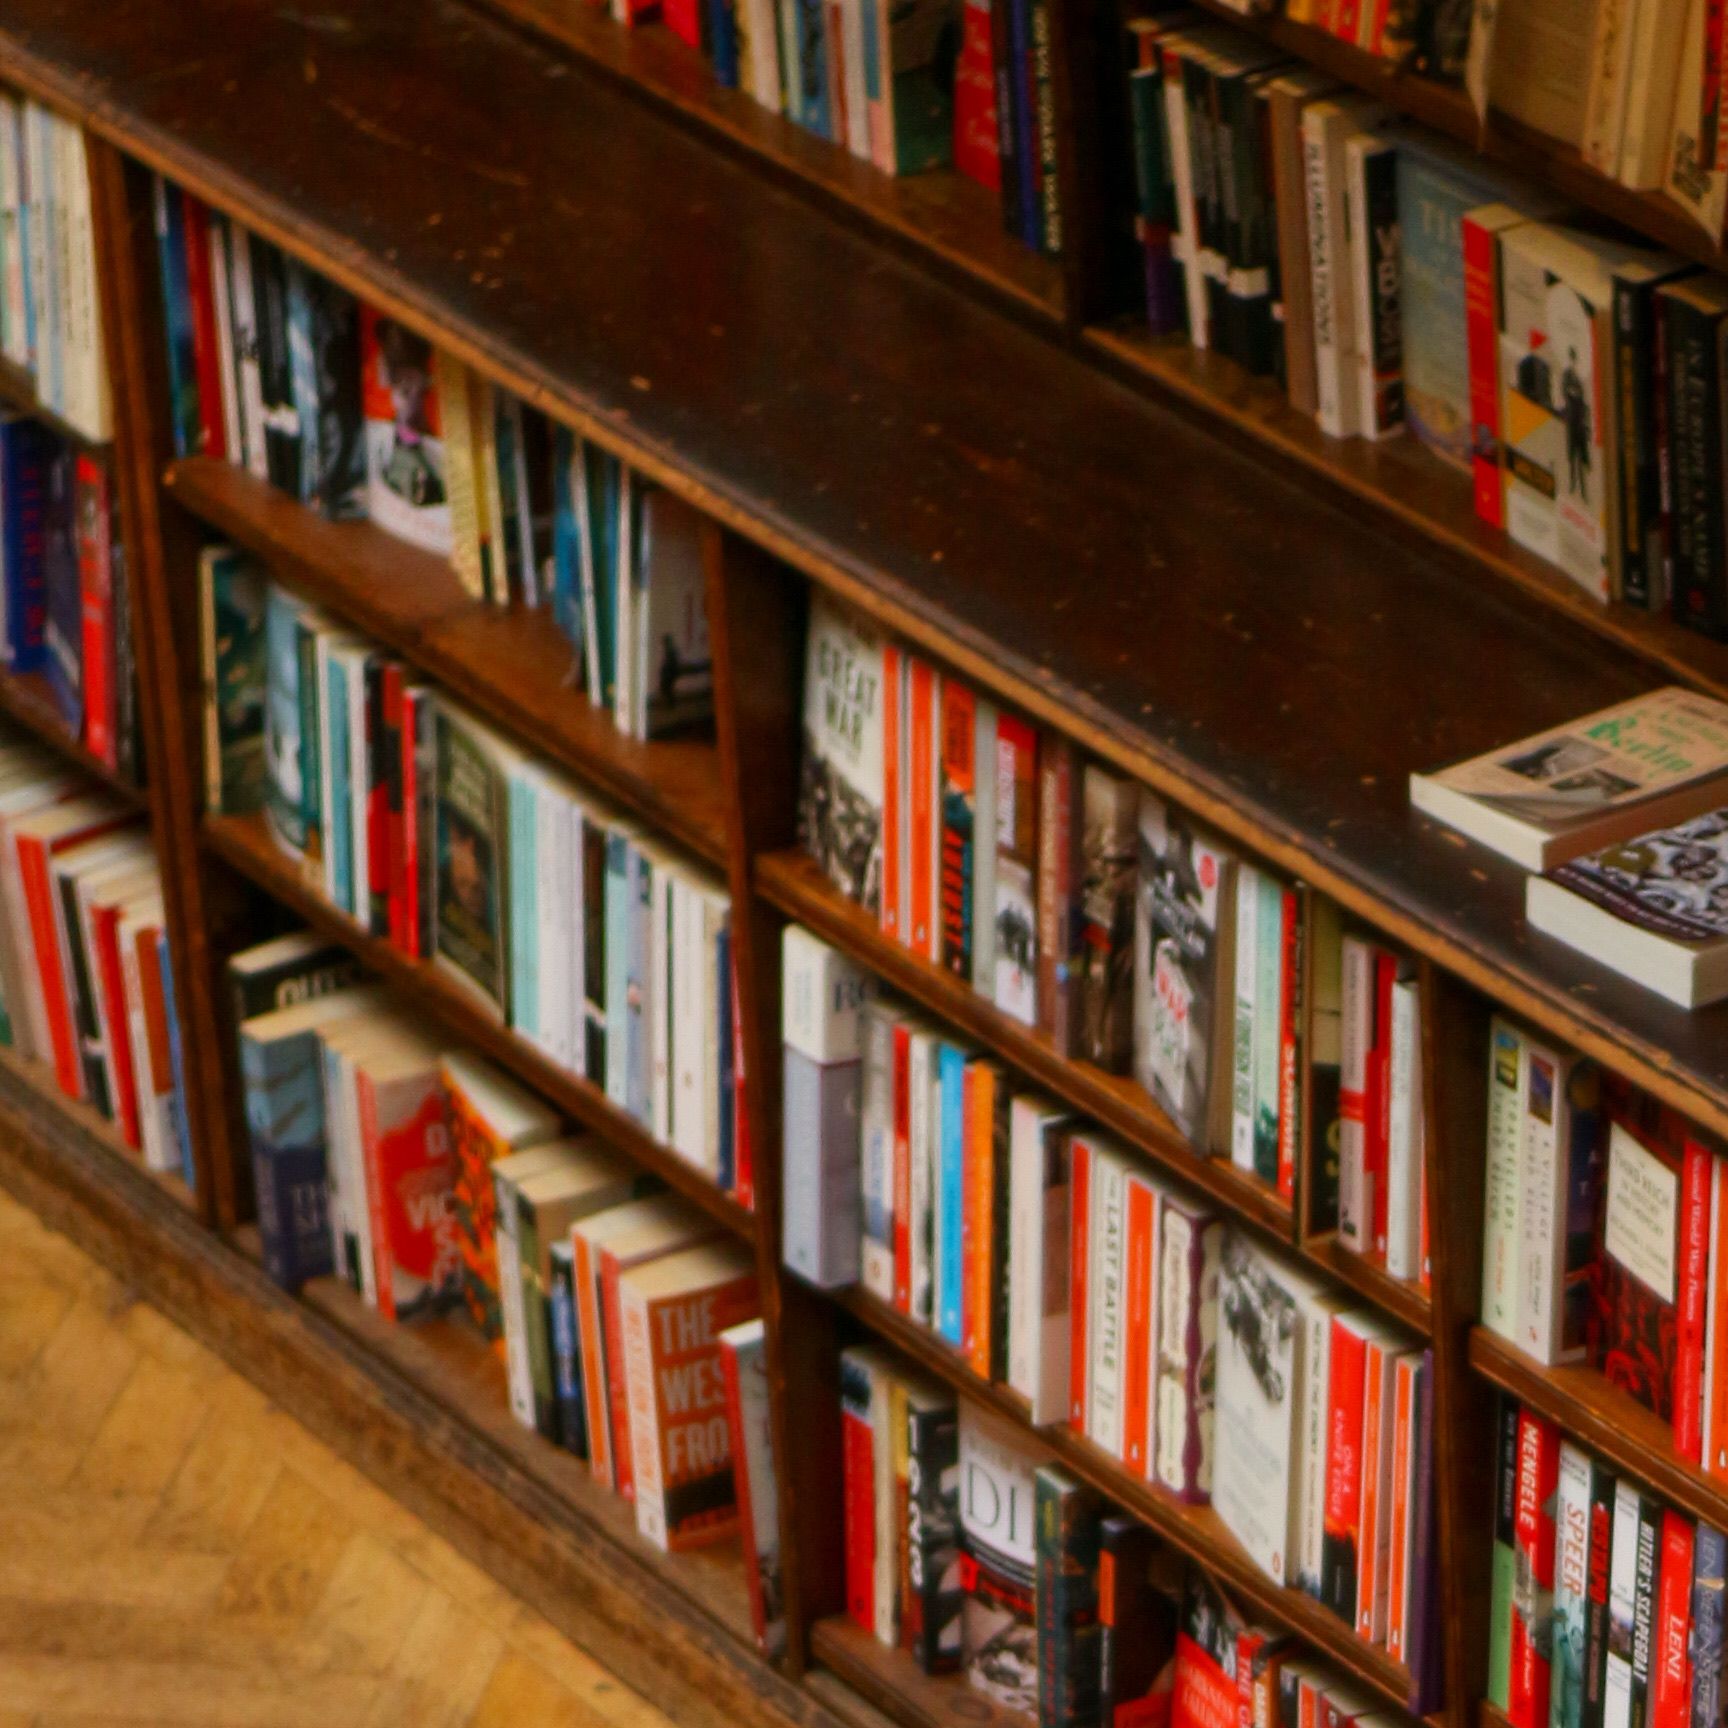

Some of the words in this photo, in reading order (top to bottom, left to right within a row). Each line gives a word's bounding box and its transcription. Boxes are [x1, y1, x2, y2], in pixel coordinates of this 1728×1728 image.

[1518, 1421, 1543, 1530] MENGELE
[1557, 1502, 1589, 1597] SPEER
[1666, 1614, 1687, 1682] LENI
